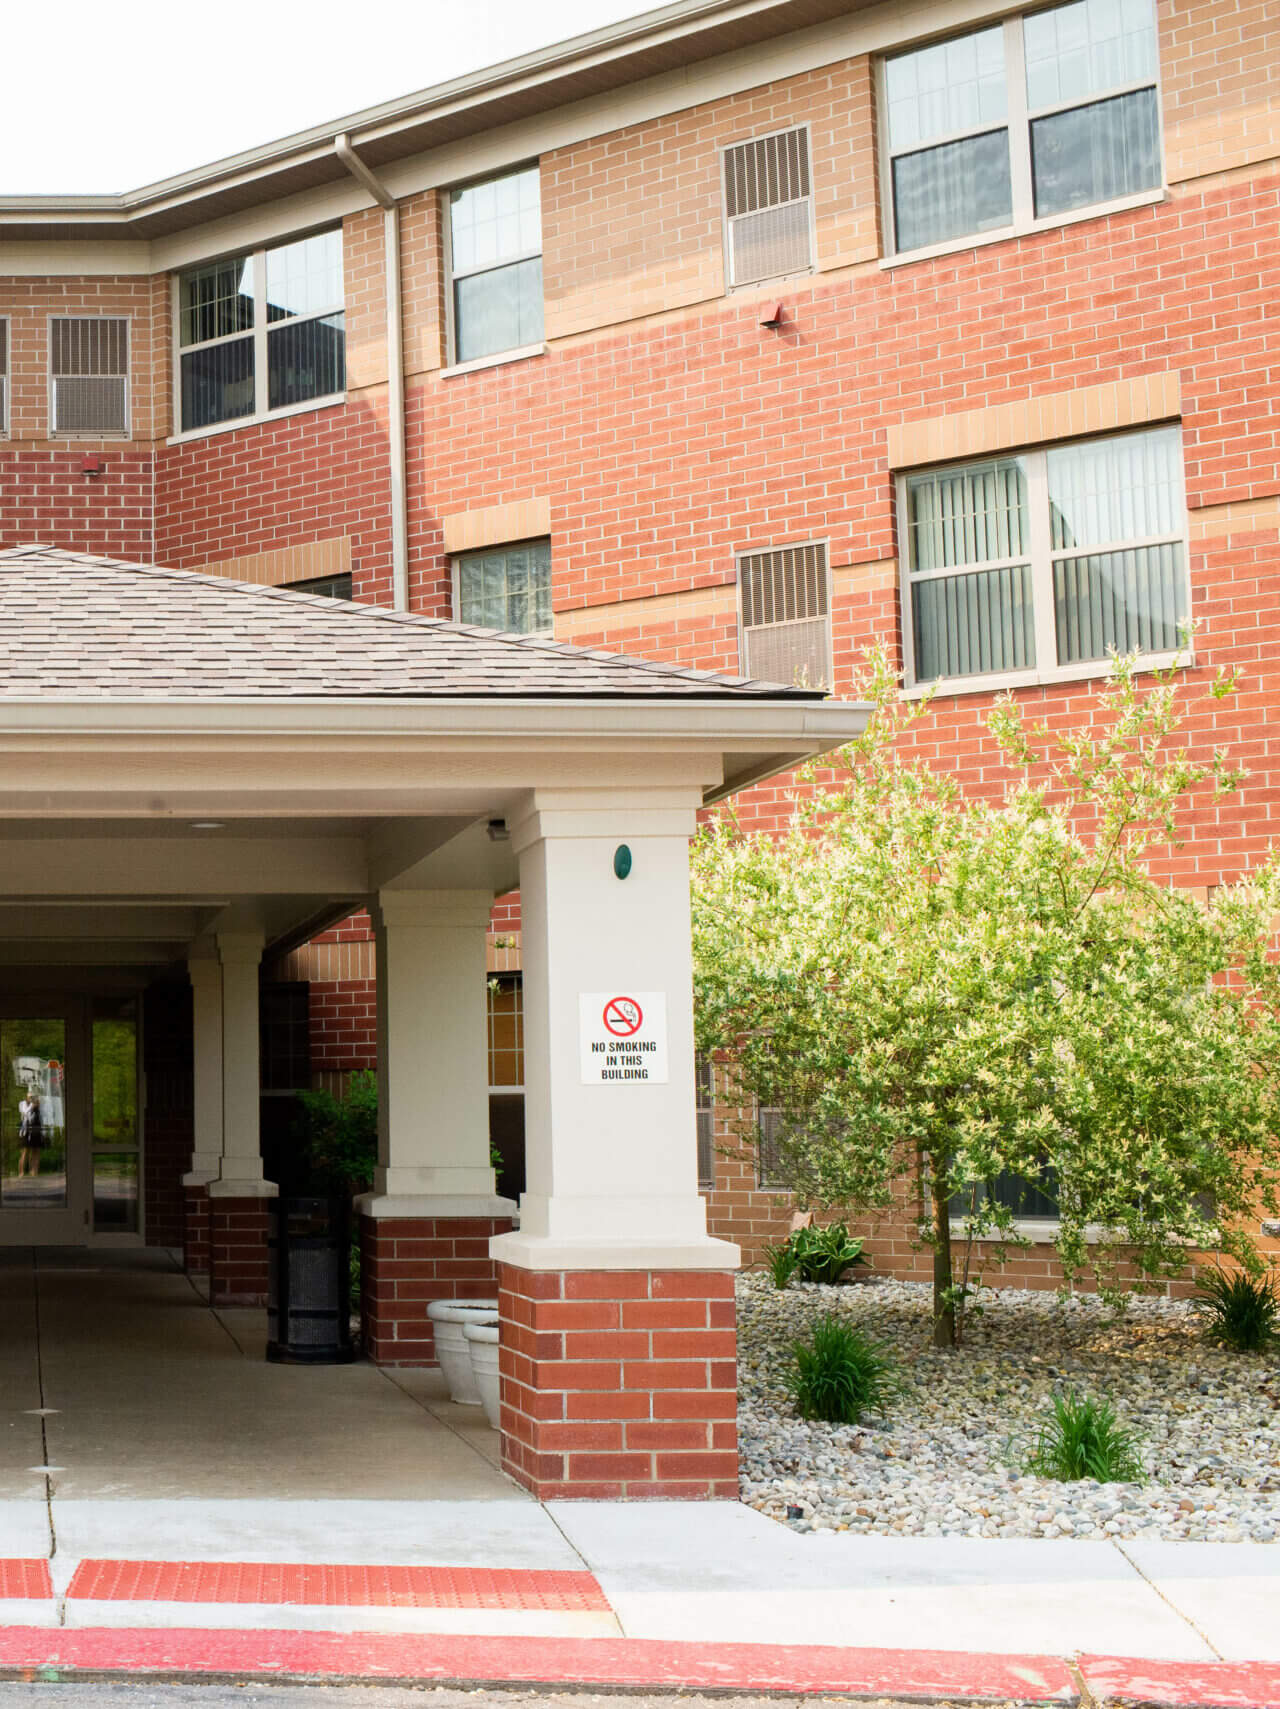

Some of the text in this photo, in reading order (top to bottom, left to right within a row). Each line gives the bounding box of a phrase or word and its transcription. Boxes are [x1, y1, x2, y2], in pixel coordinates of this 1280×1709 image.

[591, 1041, 657, 1053] NO SMOKING
[606, 1055, 643, 1066] IN THIS
[601, 1068, 649, 1080] BUILDING
